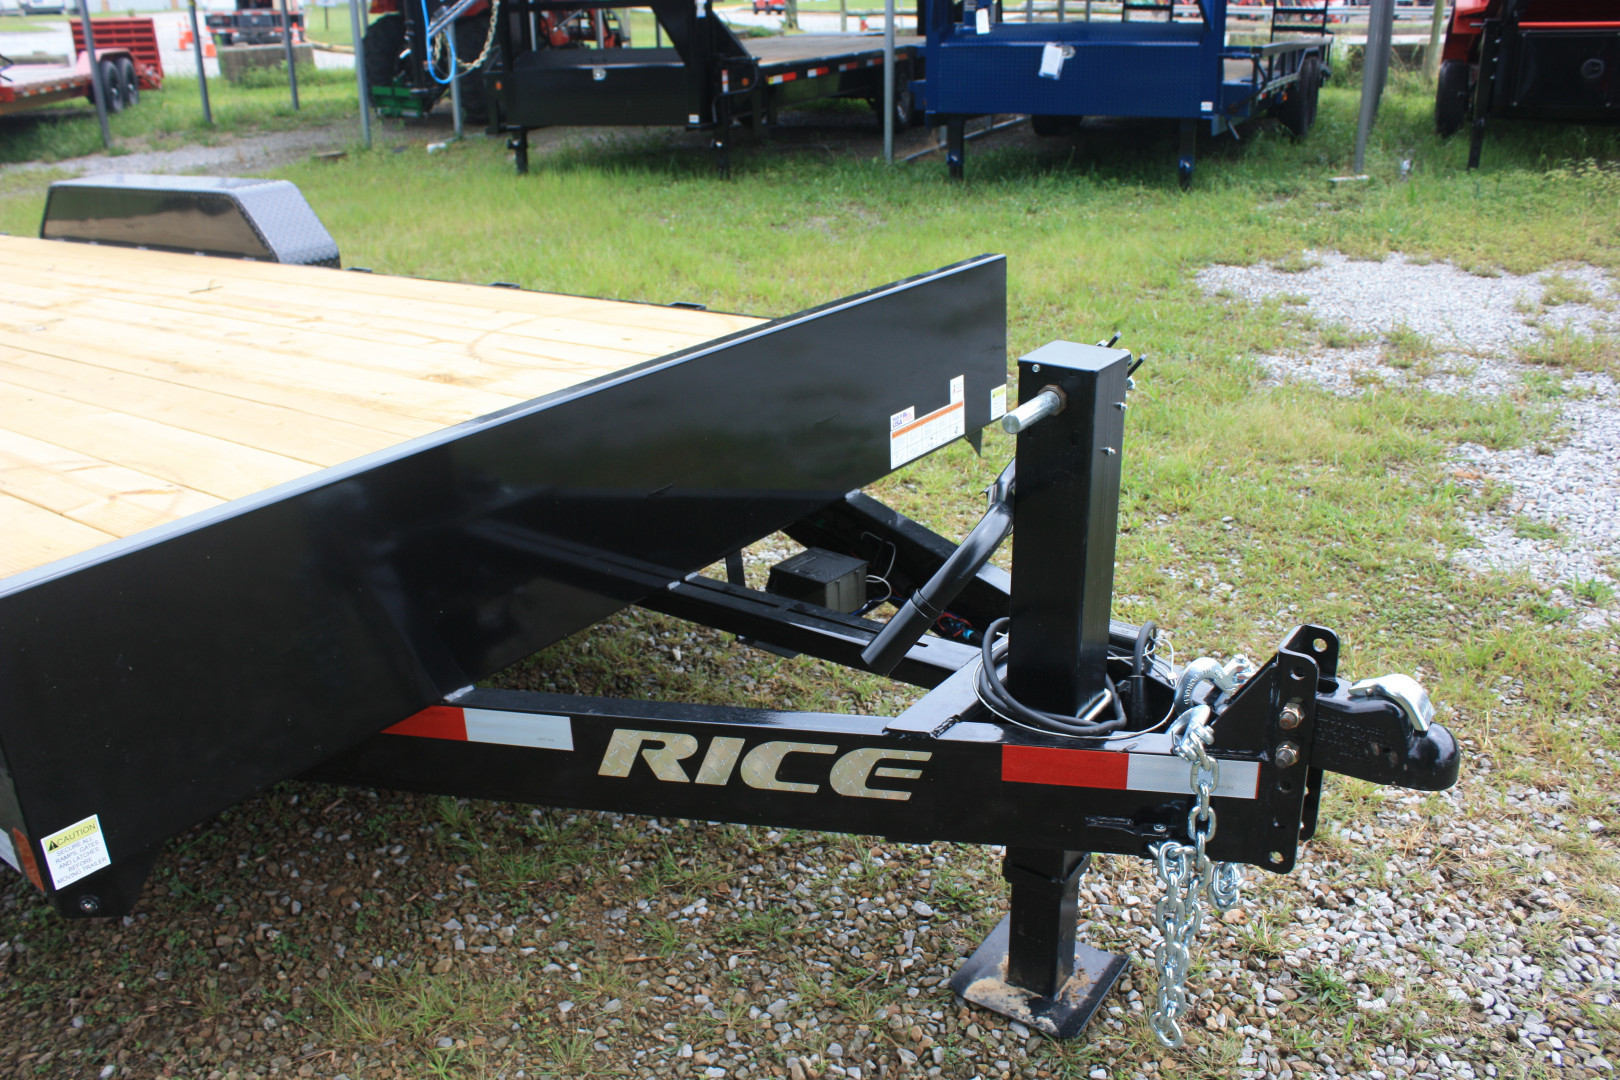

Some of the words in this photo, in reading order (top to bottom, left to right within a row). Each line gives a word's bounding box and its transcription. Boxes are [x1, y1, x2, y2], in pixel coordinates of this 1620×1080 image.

[597, 728, 933, 801] RICE
[56, 823, 96, 846] CAUTION
[57, 842, 82, 857] SECURE
[79, 840, 99, 853] GATES
[59, 859, 72, 869] AND
[73, 847, 100, 863] LATCHES
[68, 857, 92, 872] BEFORE
[57, 869, 82, 884] MOVING
[83, 856, 107, 872] TRAILER
